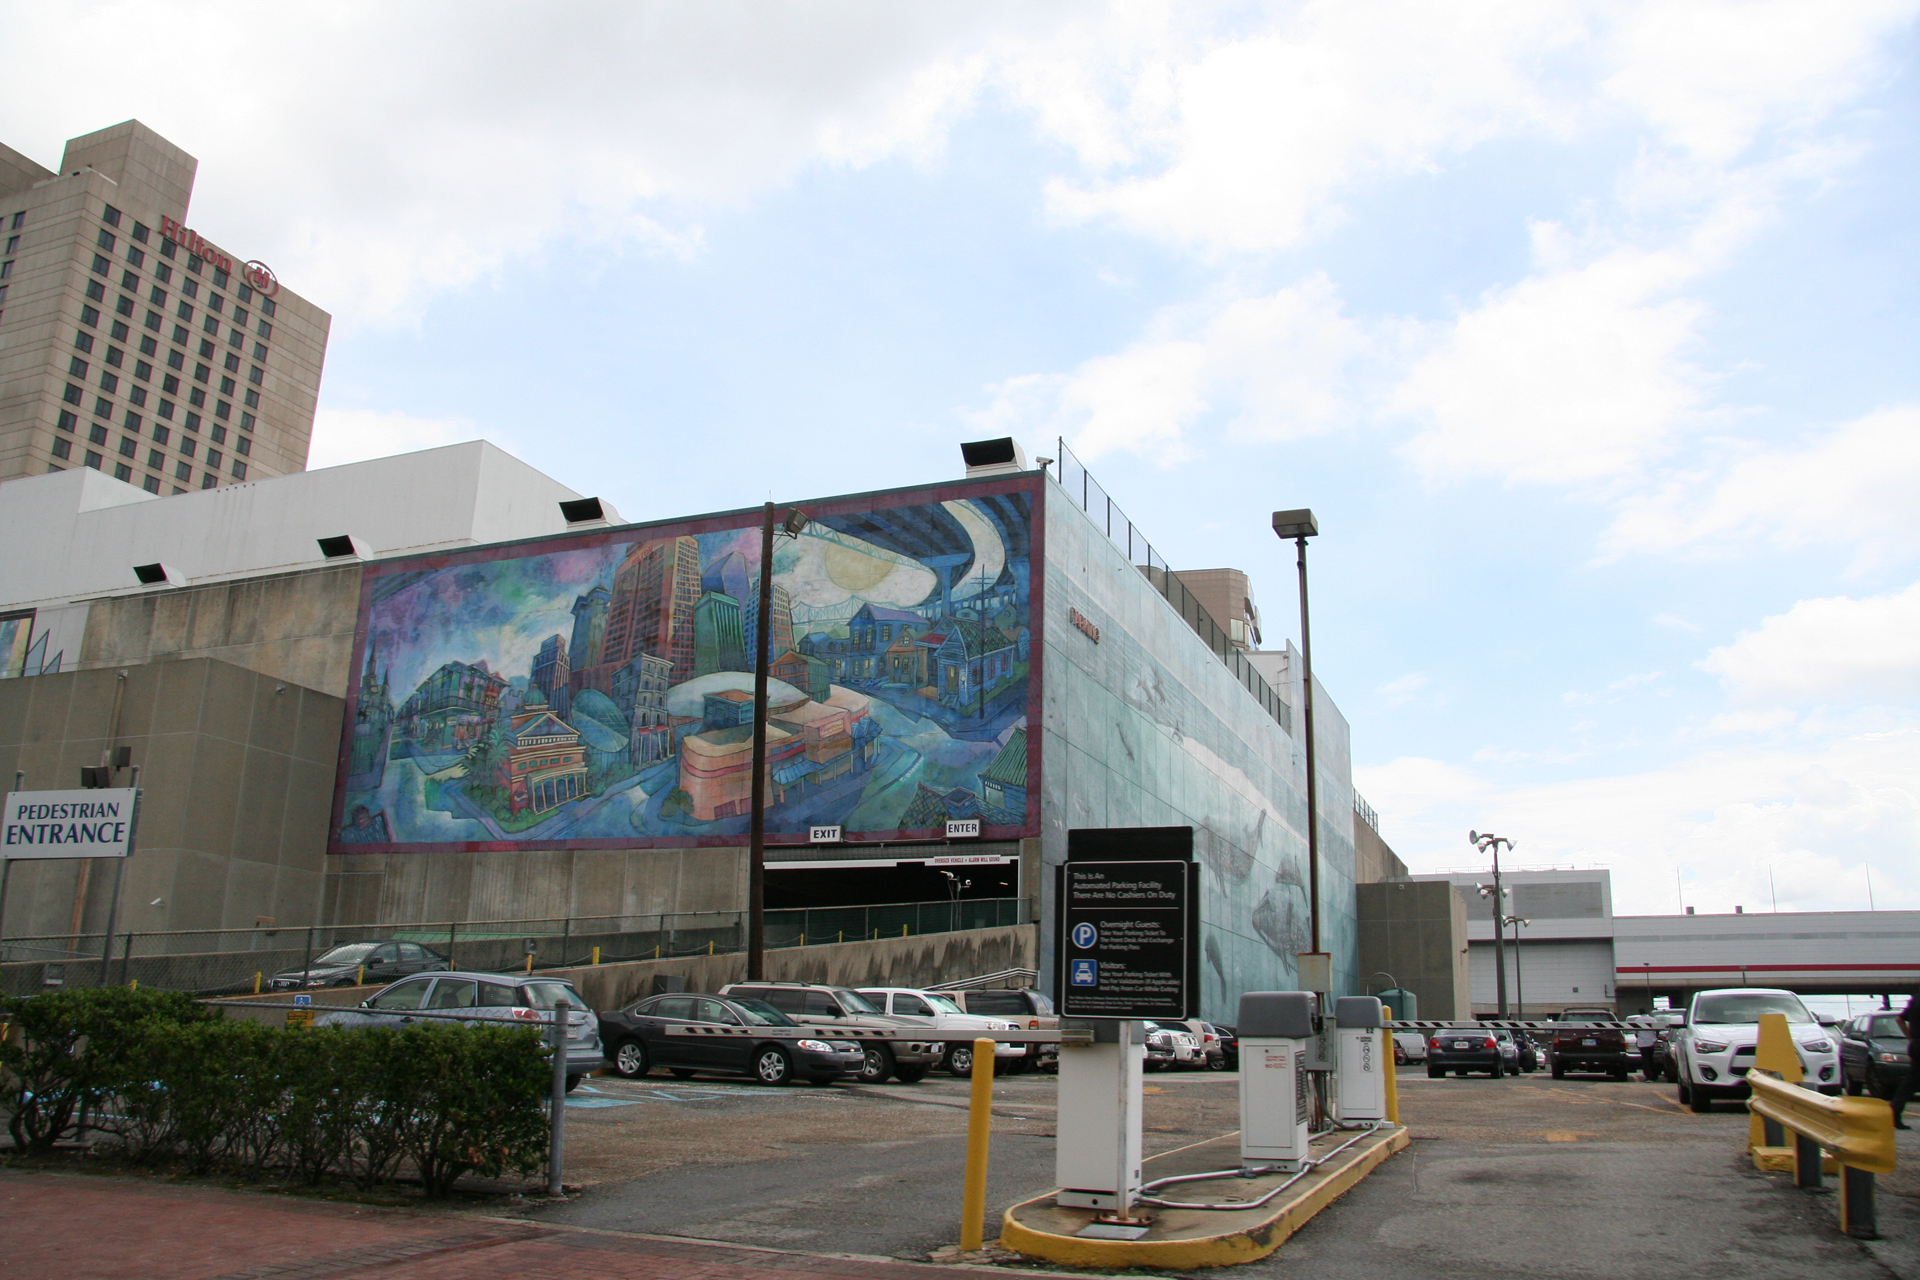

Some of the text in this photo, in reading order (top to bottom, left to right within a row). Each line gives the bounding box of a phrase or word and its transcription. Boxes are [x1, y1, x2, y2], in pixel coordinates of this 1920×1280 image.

[159, 214, 232, 275] Hilton
[1069, 606, 1099, 646] PARKING
[17, 802, 120, 820] PEDESTRIAN
[948, 823, 977, 833] ENTER
[6, 822, 126, 845] ENTRANCE
[813, 829, 837, 839] EXIT
[1073, 872, 1104, 880] This Is An
[1112, 882, 1137, 890] Parking
[1138, 882, 1162, 890] Facility
[1159, 891, 1176, 899] Duty
[1100, 921, 1134, 929] Overnight
